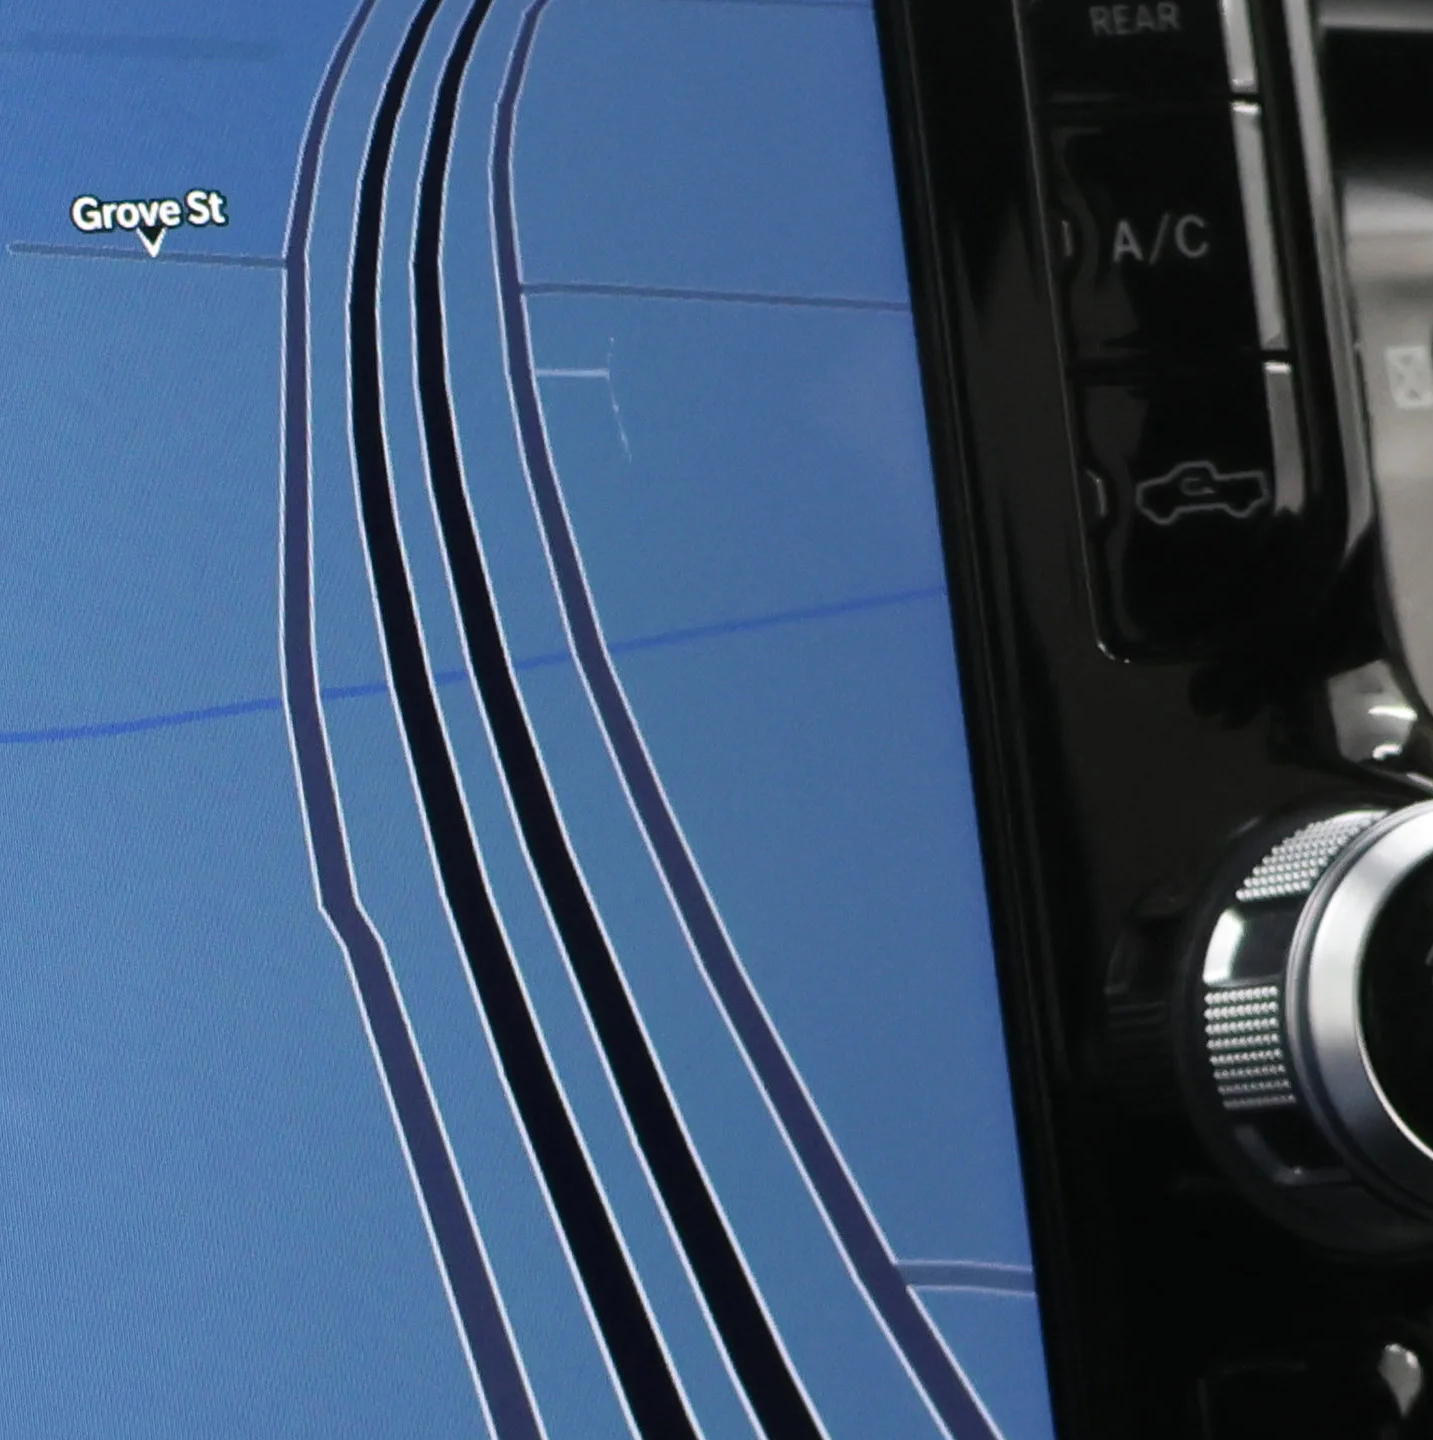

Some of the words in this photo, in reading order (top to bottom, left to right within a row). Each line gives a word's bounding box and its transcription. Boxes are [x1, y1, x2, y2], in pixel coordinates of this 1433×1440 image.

[1087, 0, 1180, 36] REAR
[70, 194, 182, 233] Grove
[185, 189, 227, 226] St
[1112, 213, 1209, 263] A/C
